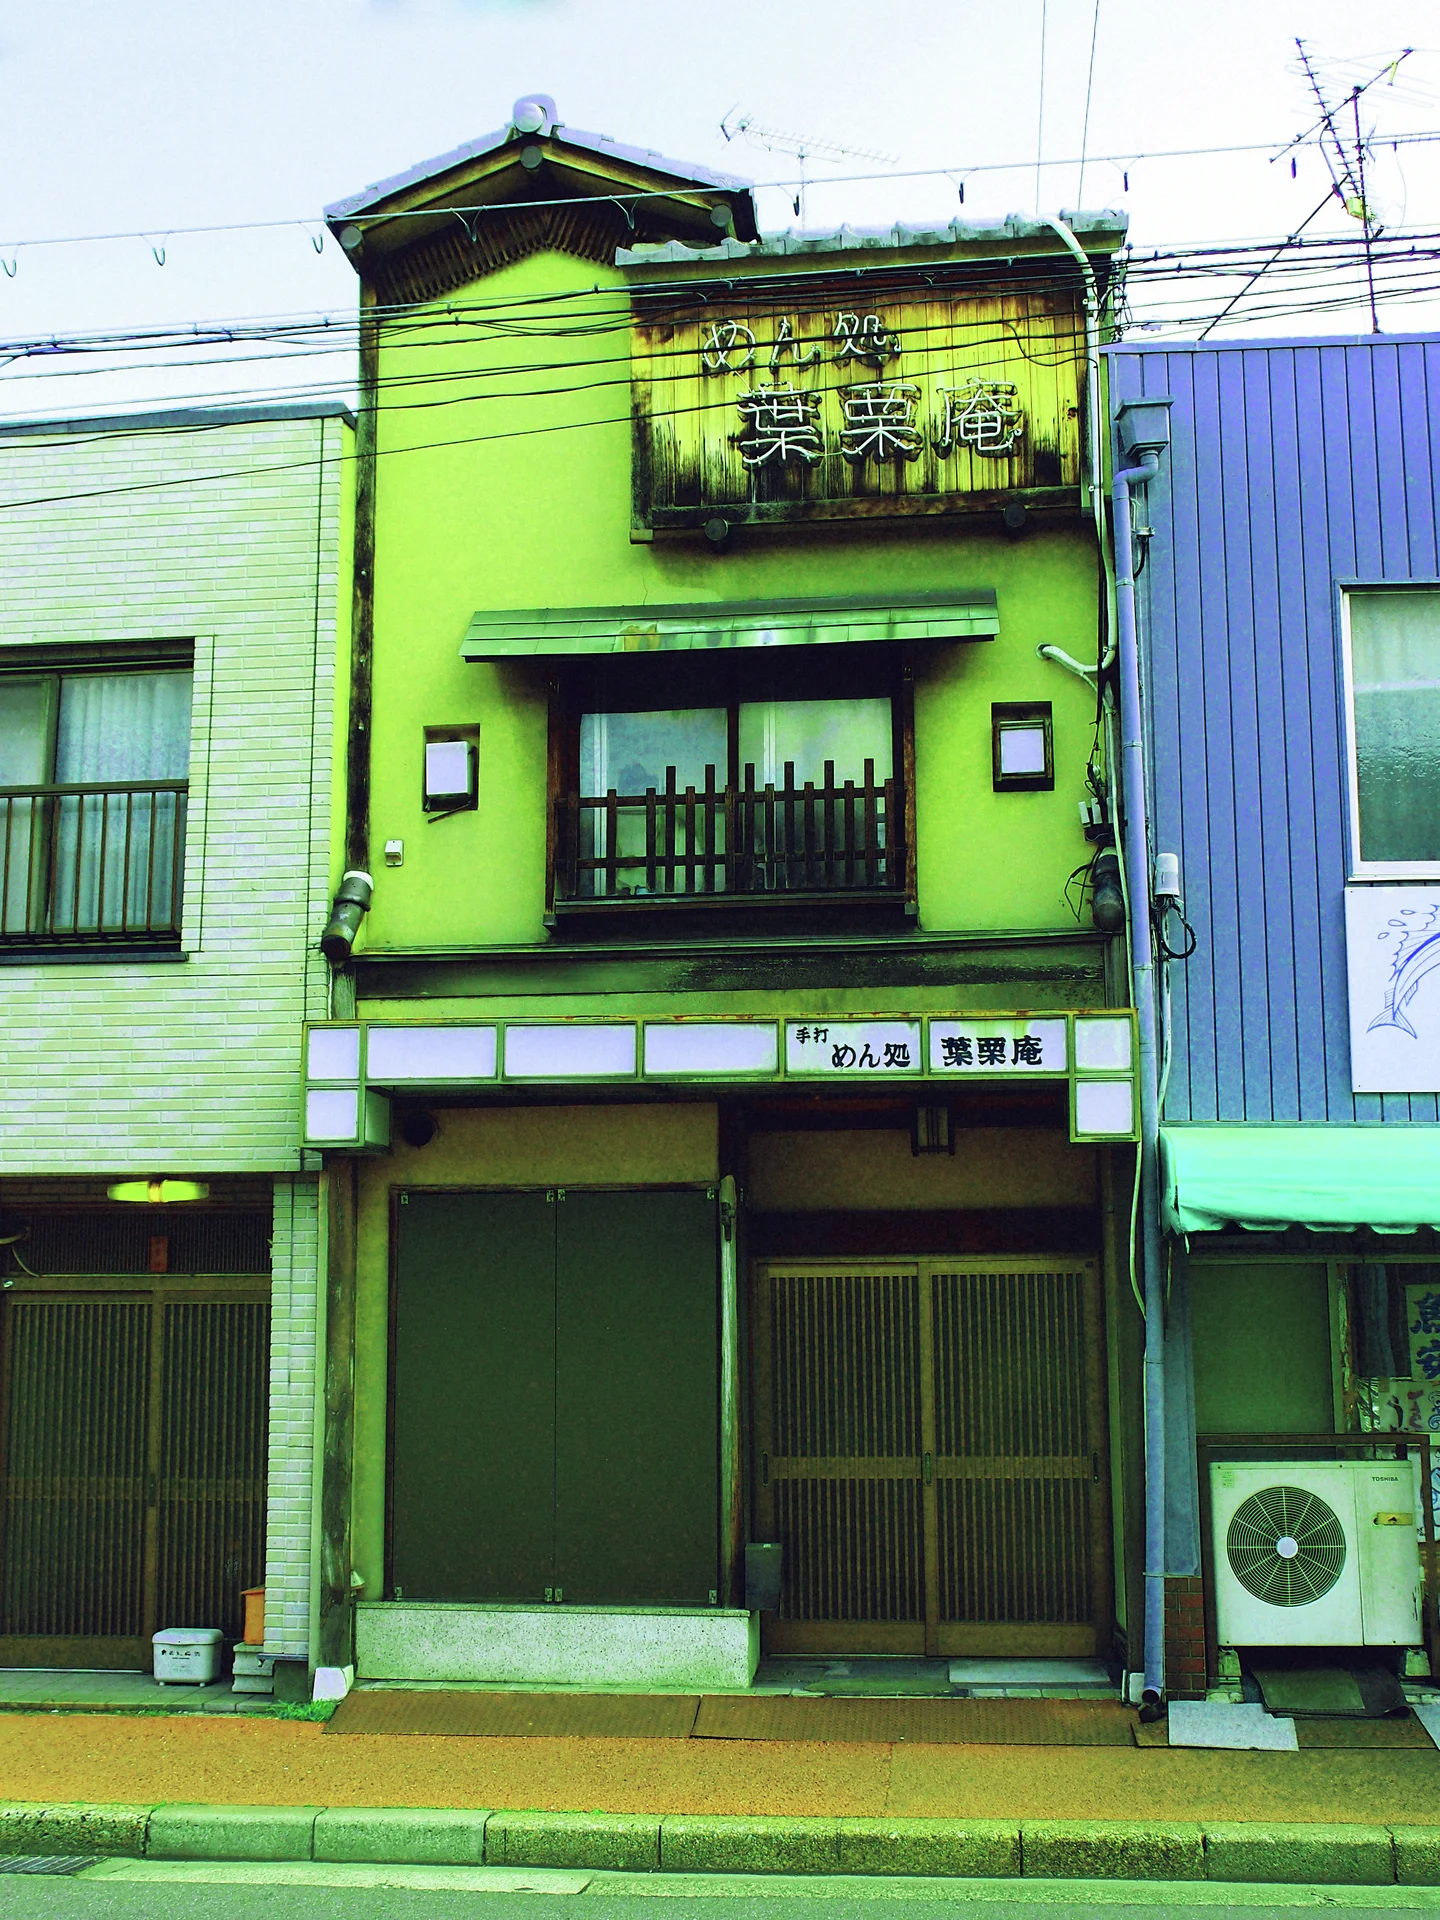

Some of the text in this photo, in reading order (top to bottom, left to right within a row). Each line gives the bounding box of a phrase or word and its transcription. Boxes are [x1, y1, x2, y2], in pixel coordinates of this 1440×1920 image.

[702, 312, 902, 371] めん処
[738, 378, 1024, 468] 葉栗庵
[796, 1027, 829, 1044] 手打
[941, 1035, 1043, 1067] 葉栗庵
[831, 1043, 911, 1068] めん処
